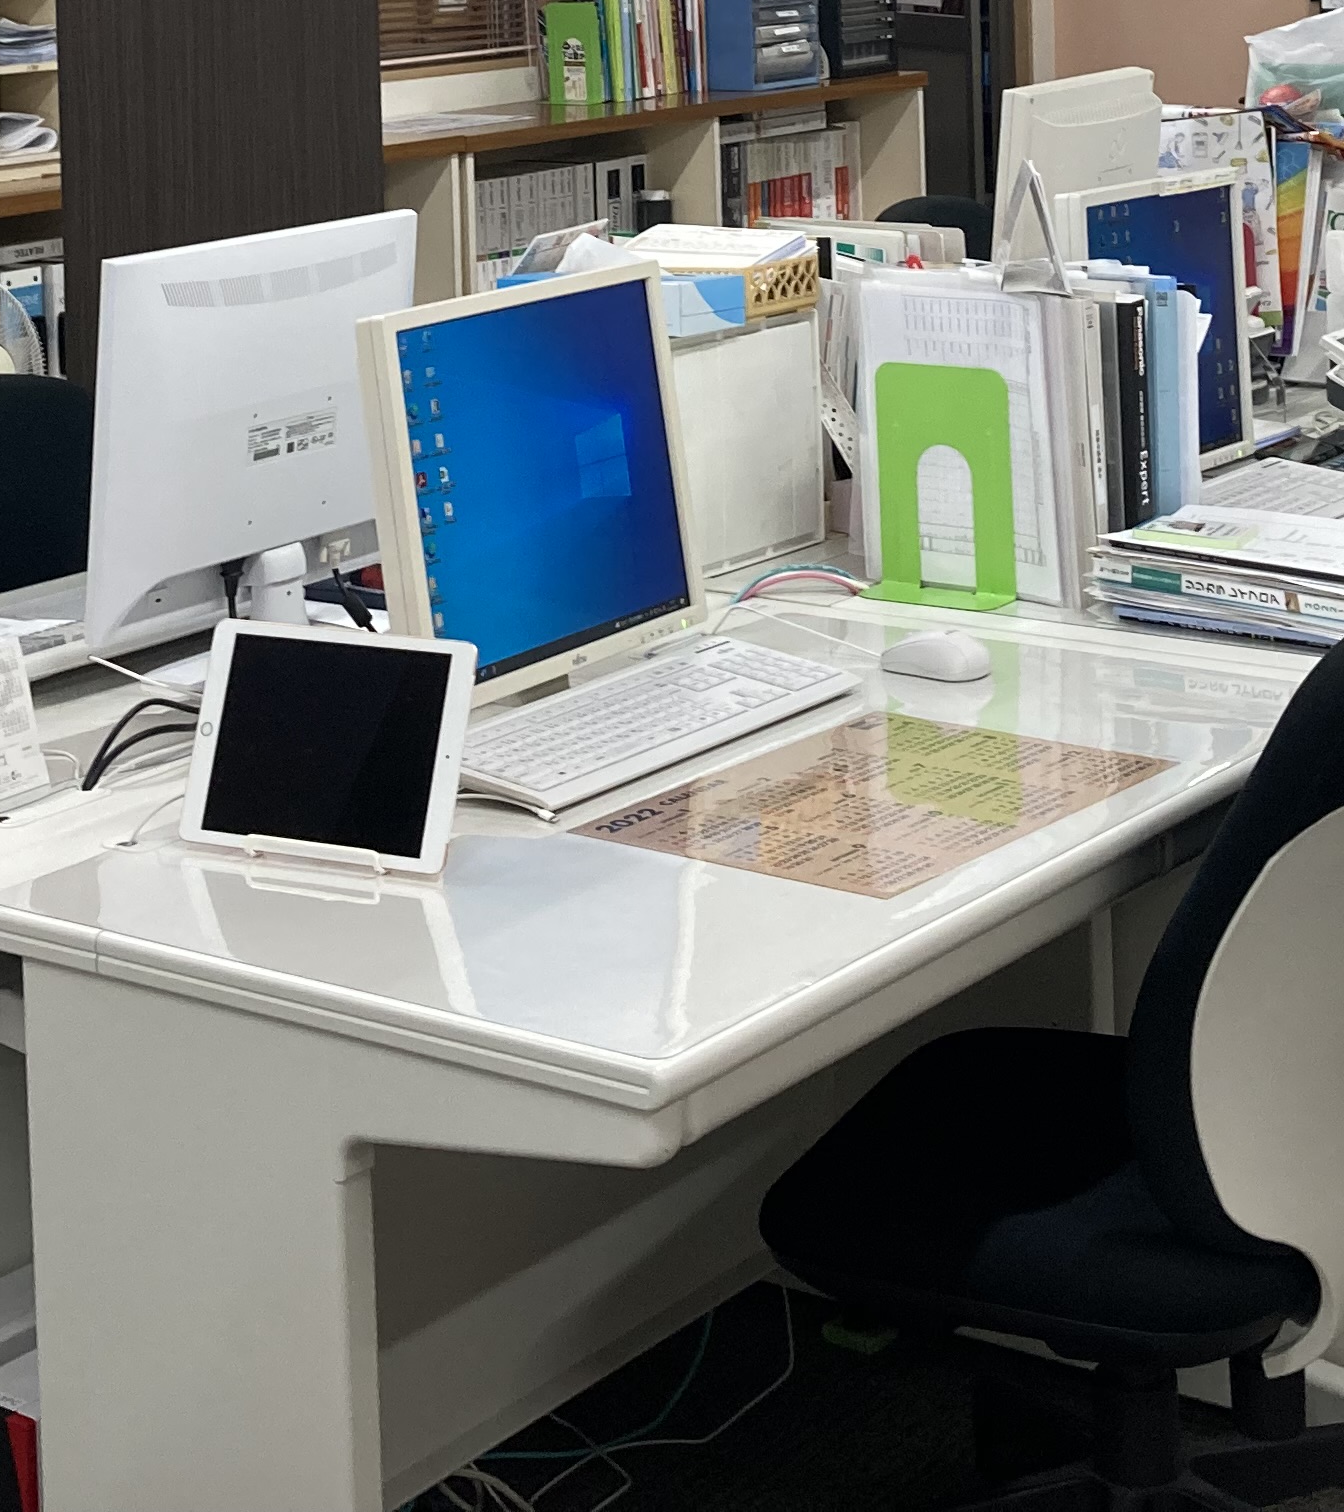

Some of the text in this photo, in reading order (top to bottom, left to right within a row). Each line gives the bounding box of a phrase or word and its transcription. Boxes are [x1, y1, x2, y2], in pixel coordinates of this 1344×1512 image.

[1136, 306, 1145, 376] Panasonic
[1139, 450, 1150, 506] Expert
[595, 808, 664, 834] 2022
